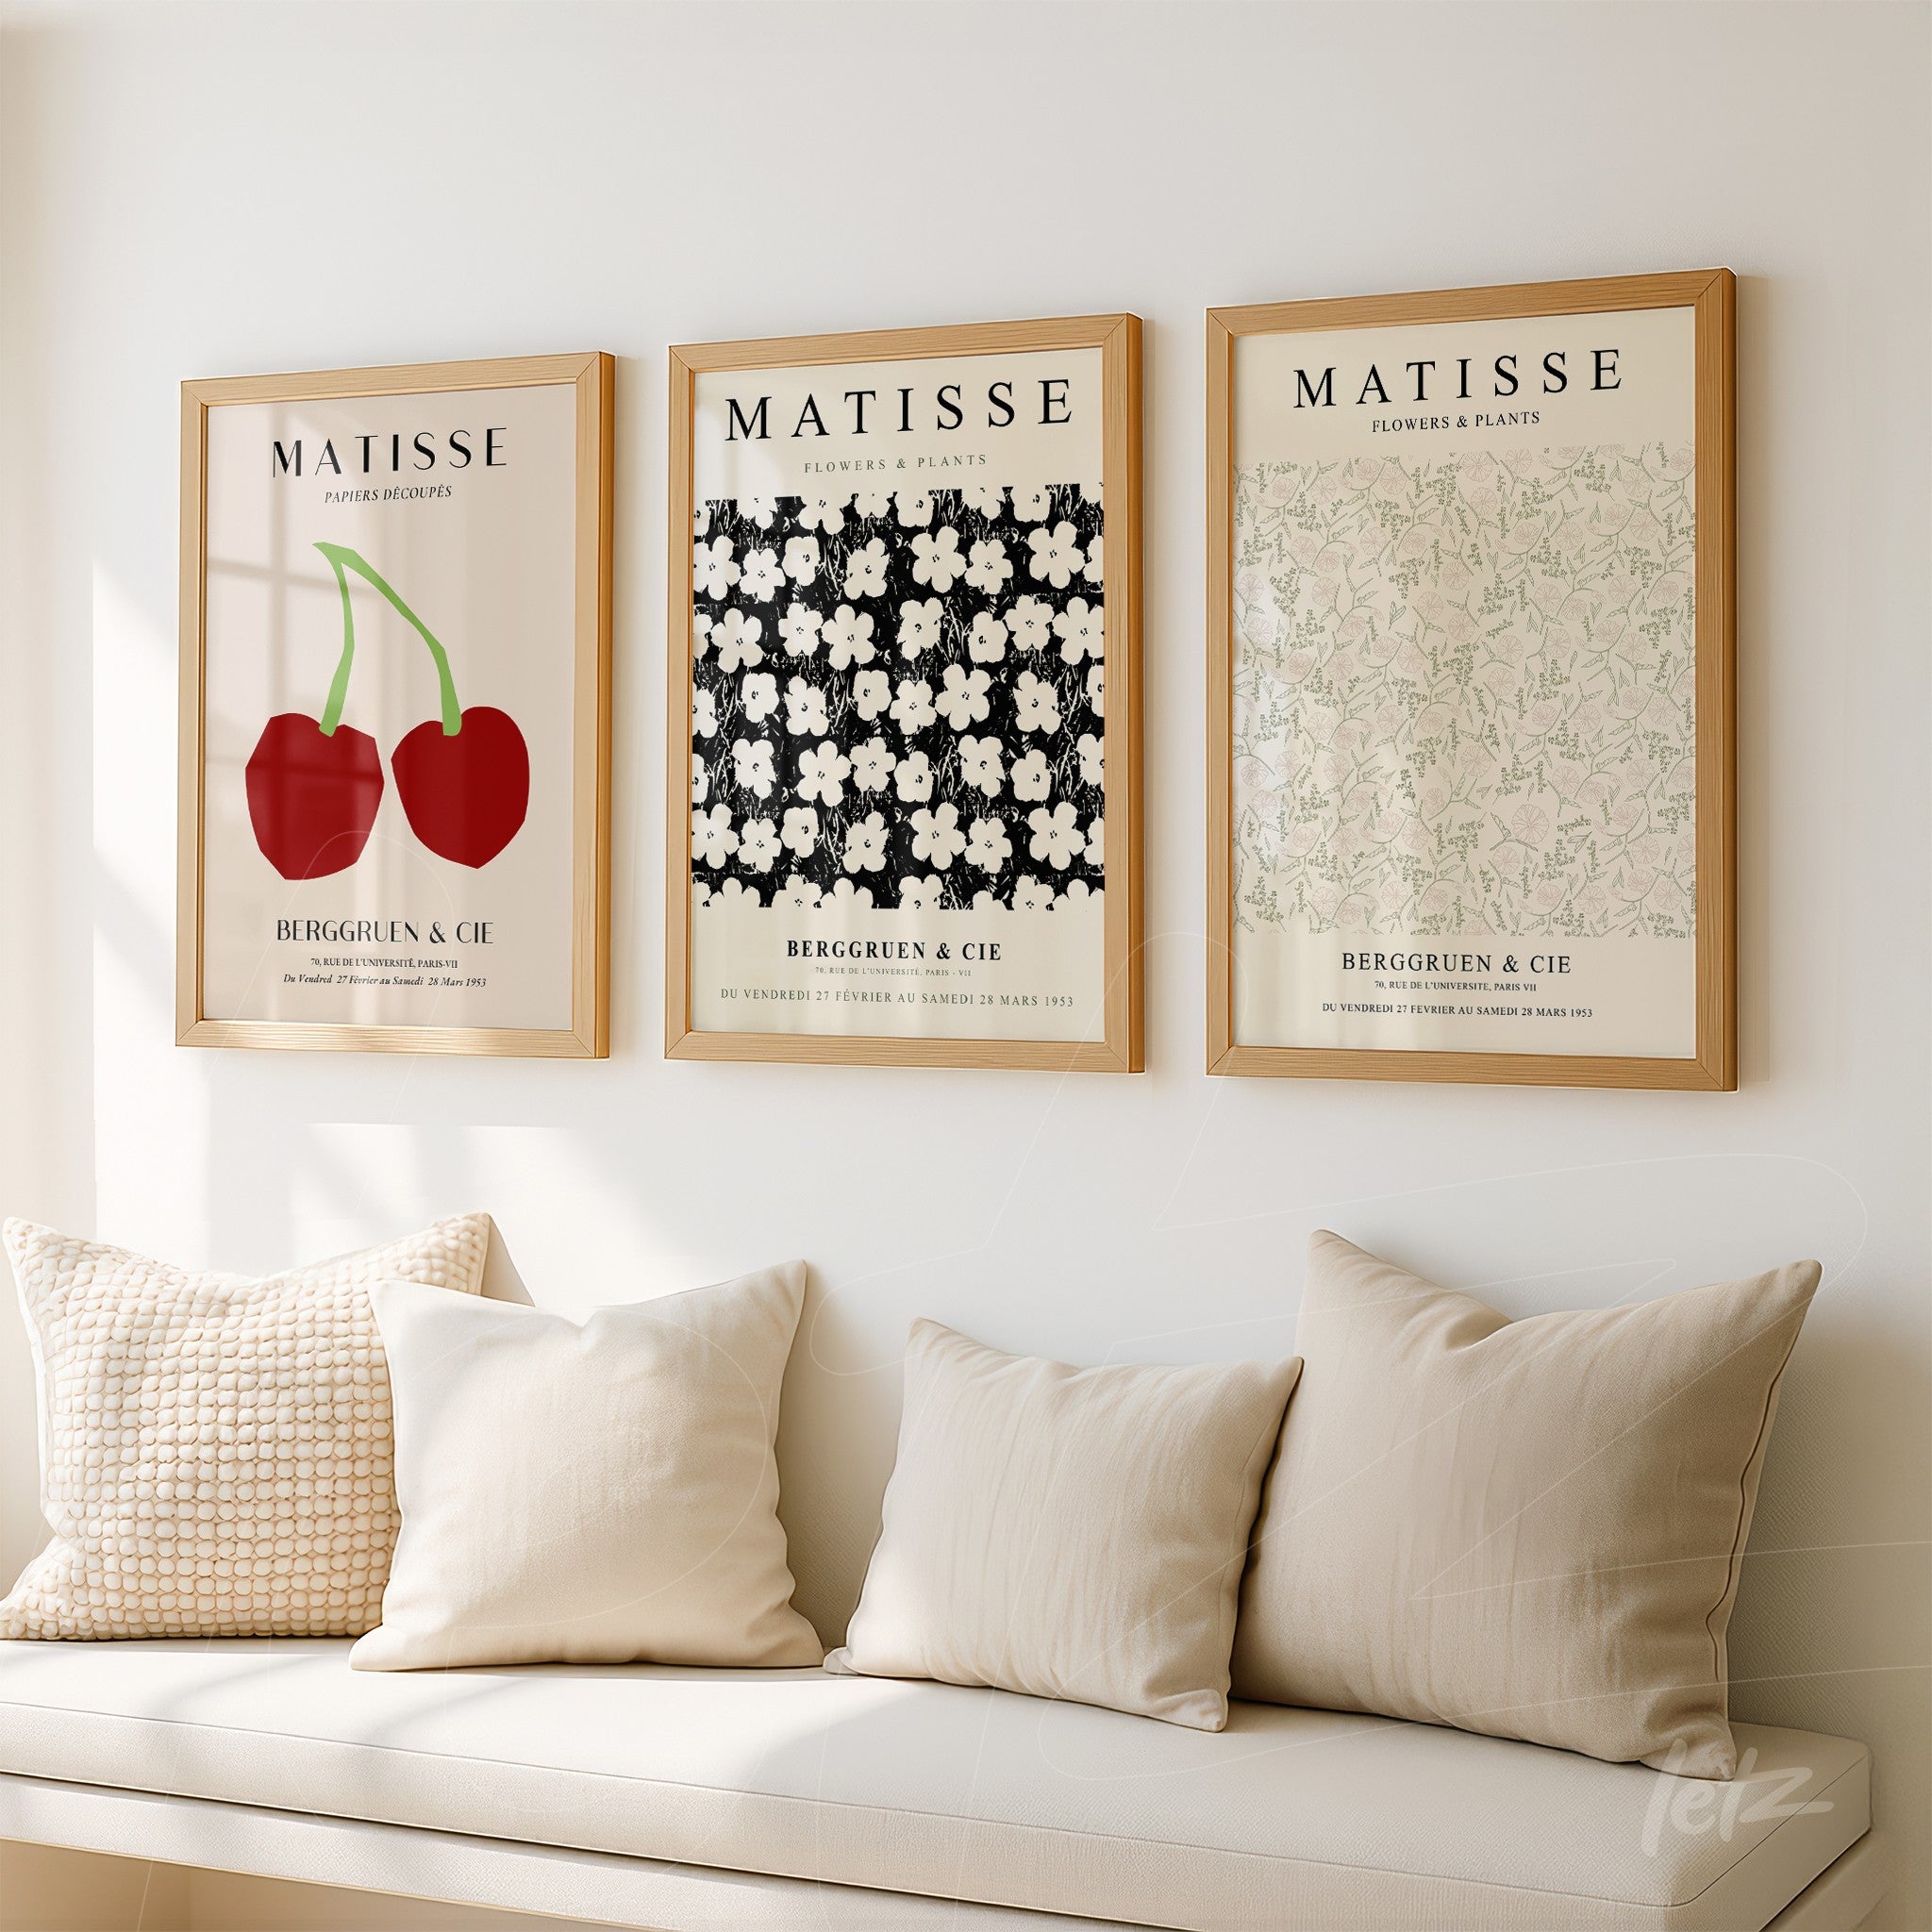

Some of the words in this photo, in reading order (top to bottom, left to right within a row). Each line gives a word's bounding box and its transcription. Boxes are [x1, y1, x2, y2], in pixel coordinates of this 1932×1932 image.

[1293, 349, 1623, 409] MATISSE
[724, 379, 1073, 441] MATISSE
[1373, 416, 1450, 433] FLOWERS
[1457, 414, 1469, 428] &
[1474, 410, 1541, 427] PLANTS
[272, 427, 508, 478] MATISSE
[805, 458, 887, 474] FLOWERS
[897, 458, 907, 469] &
[917, 454, 987, 468] PLANTS
[324, 489, 379, 504] PAPIERS
[276, 919, 420, 943] BERGGRUEN
[429, 921, 447, 944] &
[457, 921, 494, 944] CIE
[786, 940, 926, 959] BERGGRUEN
[936, 941, 952, 960] &
[962, 942, 1002, 961] CIE
[310, 958, 322, 968] 70,
[324, 958, 341, 967] RUE
[342, 958, 355, 967] DE
[418, 959, 458, 969] PARIS-VII
[1341, 952, 1492, 974] BERGGRUEN
[1503, 954, 1520, 974] &
[1530, 954, 1572, 974] CIE
[284, 974, 296, 983] Du
[336, 974, 348, 984] 27
[392, 975, 425, 986] Samedi
[427, 976, 439, 986] 28
[441, 976, 464, 987] Mars
[465, 977, 487, 988] 1953
[1374, 980, 1386, 991] 70,
[1390, 981, 1407, 990] RUE
[1410, 981, 1423, 990] DE
[1494, 983, 1520, 991] PARIS
[1524, 983, 1537, 991] VII
[721, 988, 739, 999] DU
[743, 988, 810, 1001] VENDREDI
[816, 990, 830, 1001] 27
[836, 988, 892, 1003] FÉVRIER
[898, 992, 916, 1004] AU
[923, 993, 974, 1005] SAMEDI
[979, 993, 994, 1006] 28
[1000, 995, 1038, 1007] MARS
[1045, 996, 1074, 1008] 1953
[1323, 1003, 1338, 1012] DU
[1341, 1003, 1393, 1013] VENDREDI
[1397, 1004, 1407, 1014] 27
[1410, 1005, 1456, 1015] FEVRIER
[1458, 1006, 1474, 1016] AU
[1476, 1006, 1519, 1017] SAMEDI
[1522, 1007, 1533, 1017] 28
[1536, 1007, 1567, 1018] MARS
[1570, 1008, 1593, 1019] 1953
